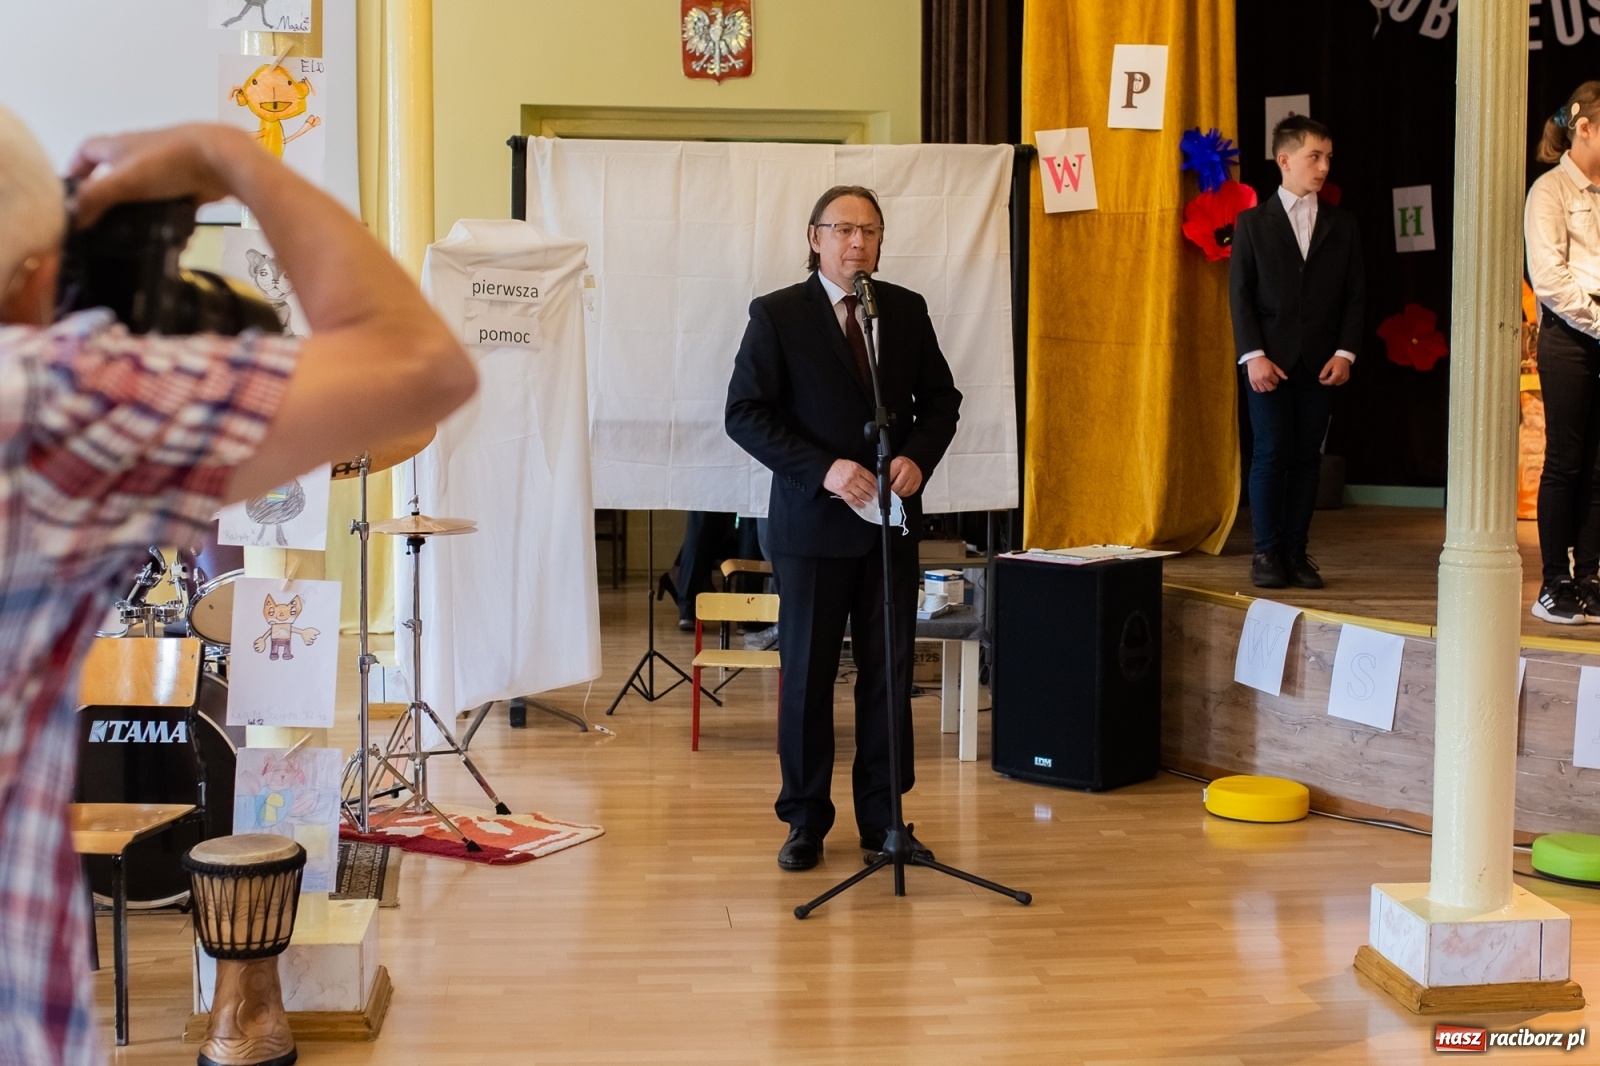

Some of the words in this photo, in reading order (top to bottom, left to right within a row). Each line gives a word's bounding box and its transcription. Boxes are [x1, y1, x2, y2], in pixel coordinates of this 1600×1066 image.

[1121, 71, 1151, 109] P
[1042, 154, 1086, 194] W
[472, 279, 539, 299] pierwsza
[479, 328, 531, 344] pomoc
[1247, 618, 1286, 670] W
[1347, 652, 1377, 701] S
[107, 720, 188, 743] TAMA
